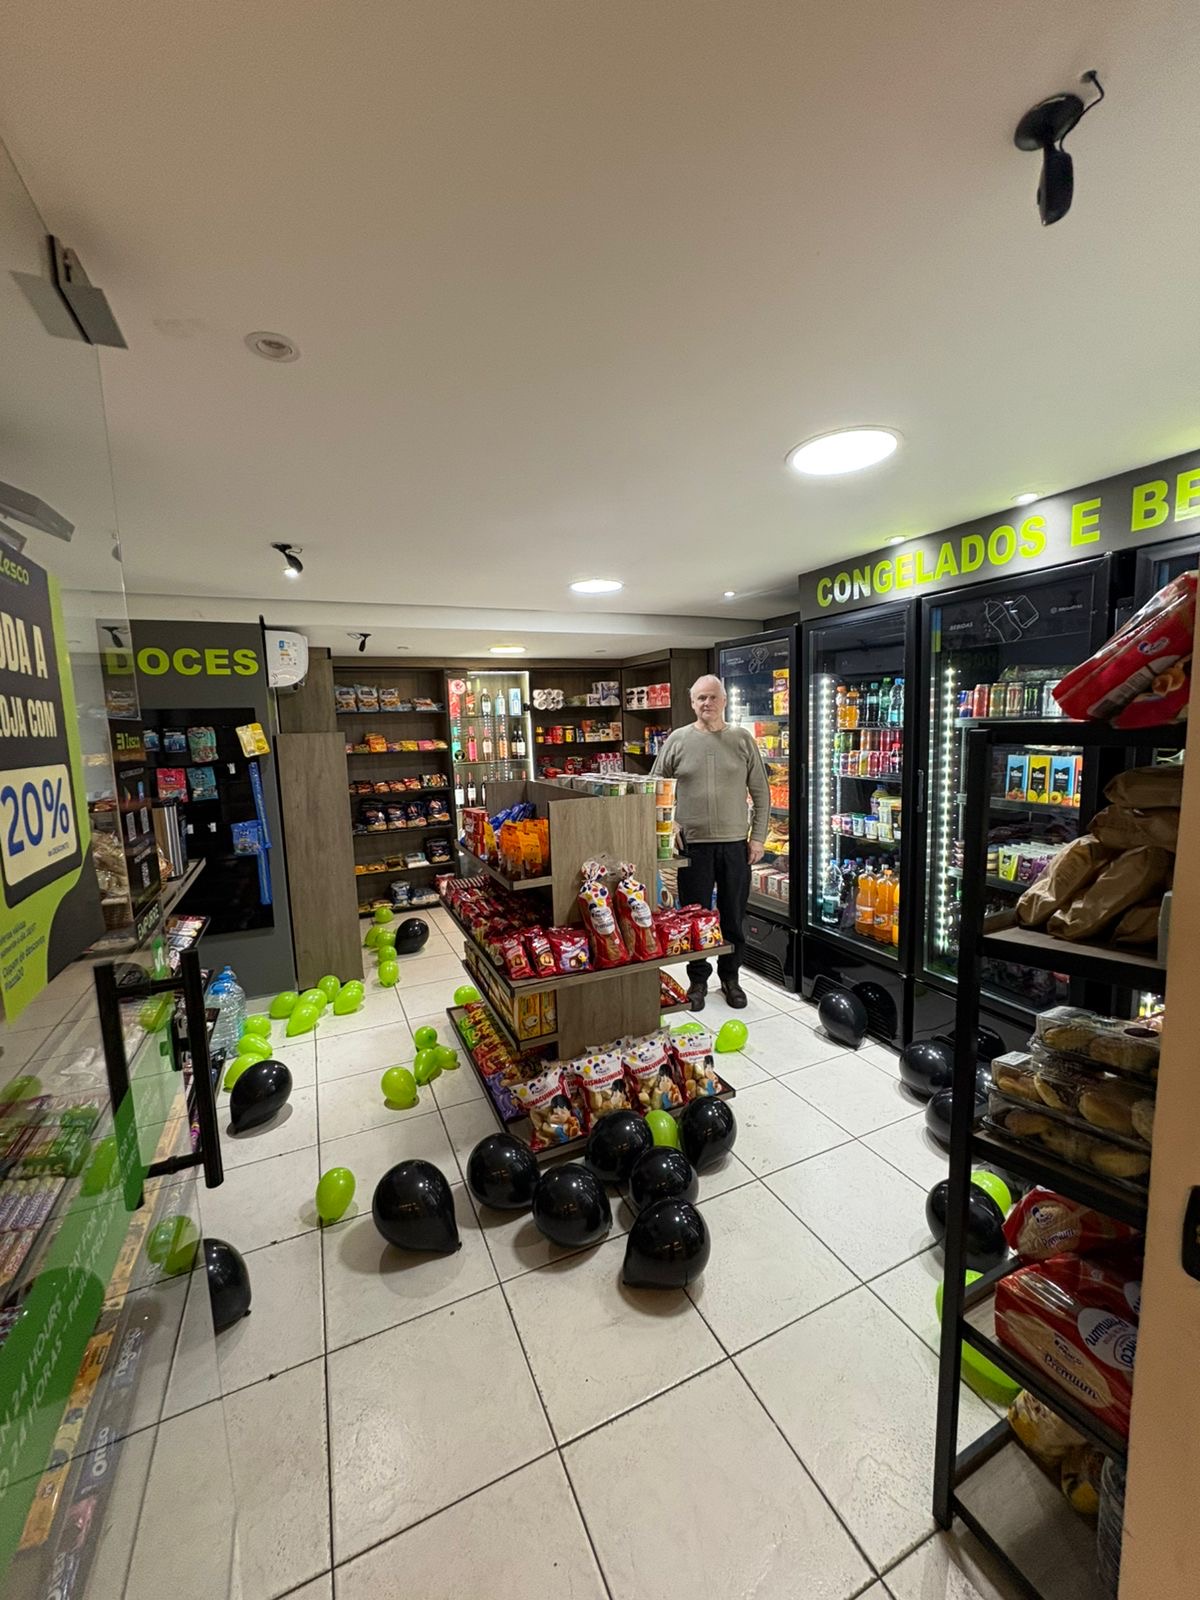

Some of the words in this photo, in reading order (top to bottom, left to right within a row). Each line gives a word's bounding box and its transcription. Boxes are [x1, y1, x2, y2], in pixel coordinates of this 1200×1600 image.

[816, 515, 1047, 608] CONGELADOS
[1070, 497, 1102, 547] E
[32, 624, 49, 680] A
[105, 647, 260, 676] DOCES
[27, 698, 58, 738] COM
[1, 777, 70, 858] 20%
[1044, 1353, 1100, 1400] Premium
